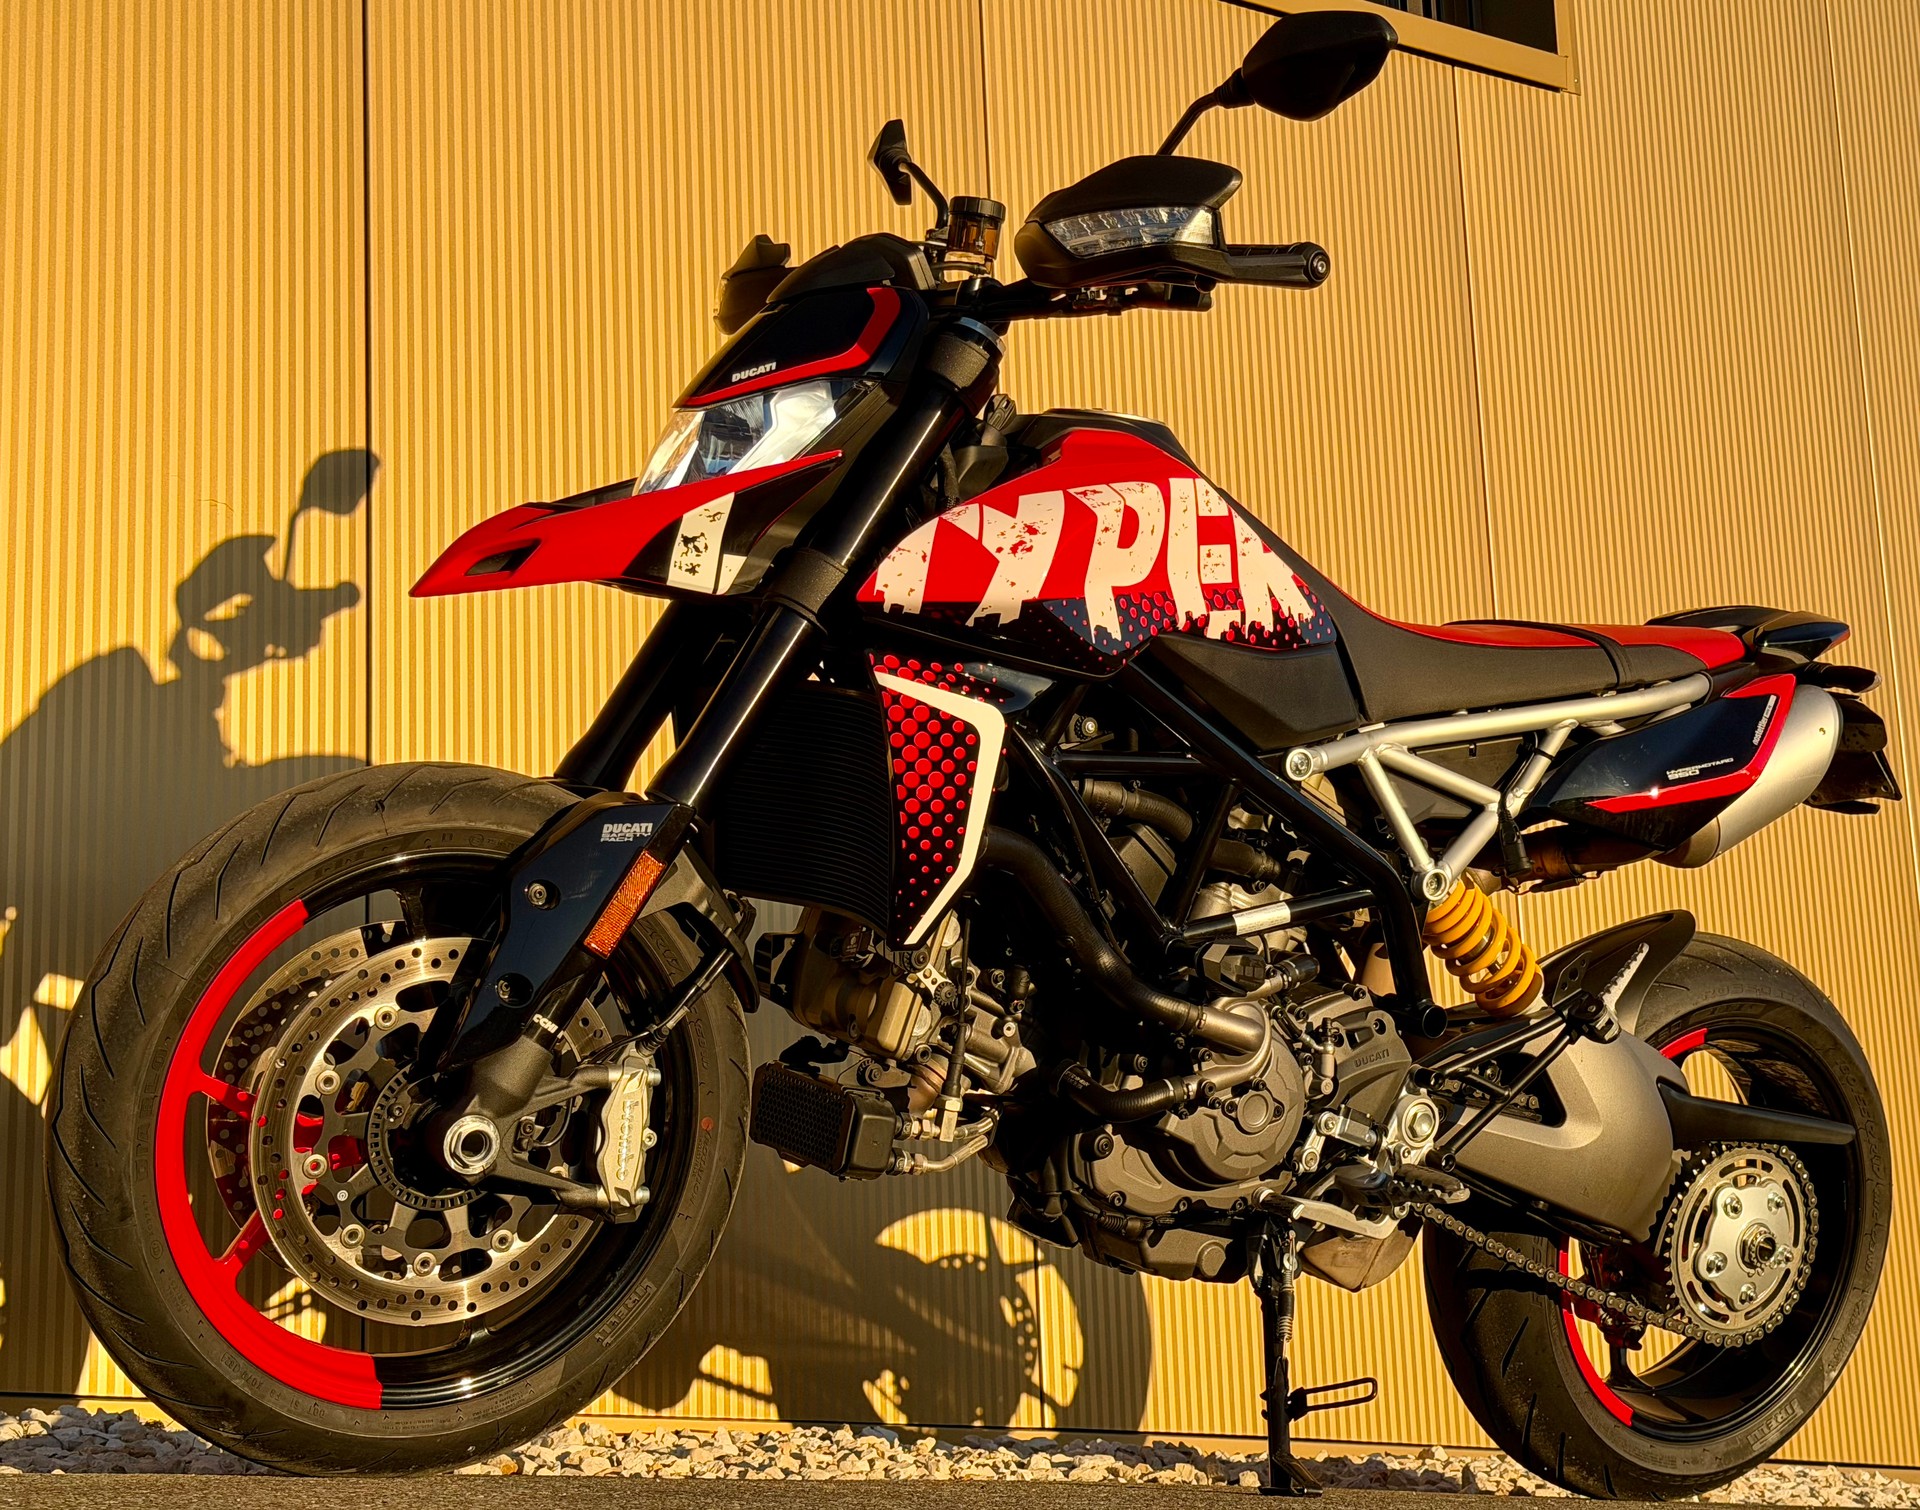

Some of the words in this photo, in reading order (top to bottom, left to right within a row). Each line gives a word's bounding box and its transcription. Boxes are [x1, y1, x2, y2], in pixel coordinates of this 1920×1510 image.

[731, 361, 777, 382] DUCATI
[1666, 757, 1735, 776] HYPERMOTARD
[602, 822, 654, 834] DUCATI
[1354, 1048, 1390, 1068] DUCATI
[616, 1100, 639, 1181] brembo
[1745, 1398, 1805, 1452] PIRELLI
